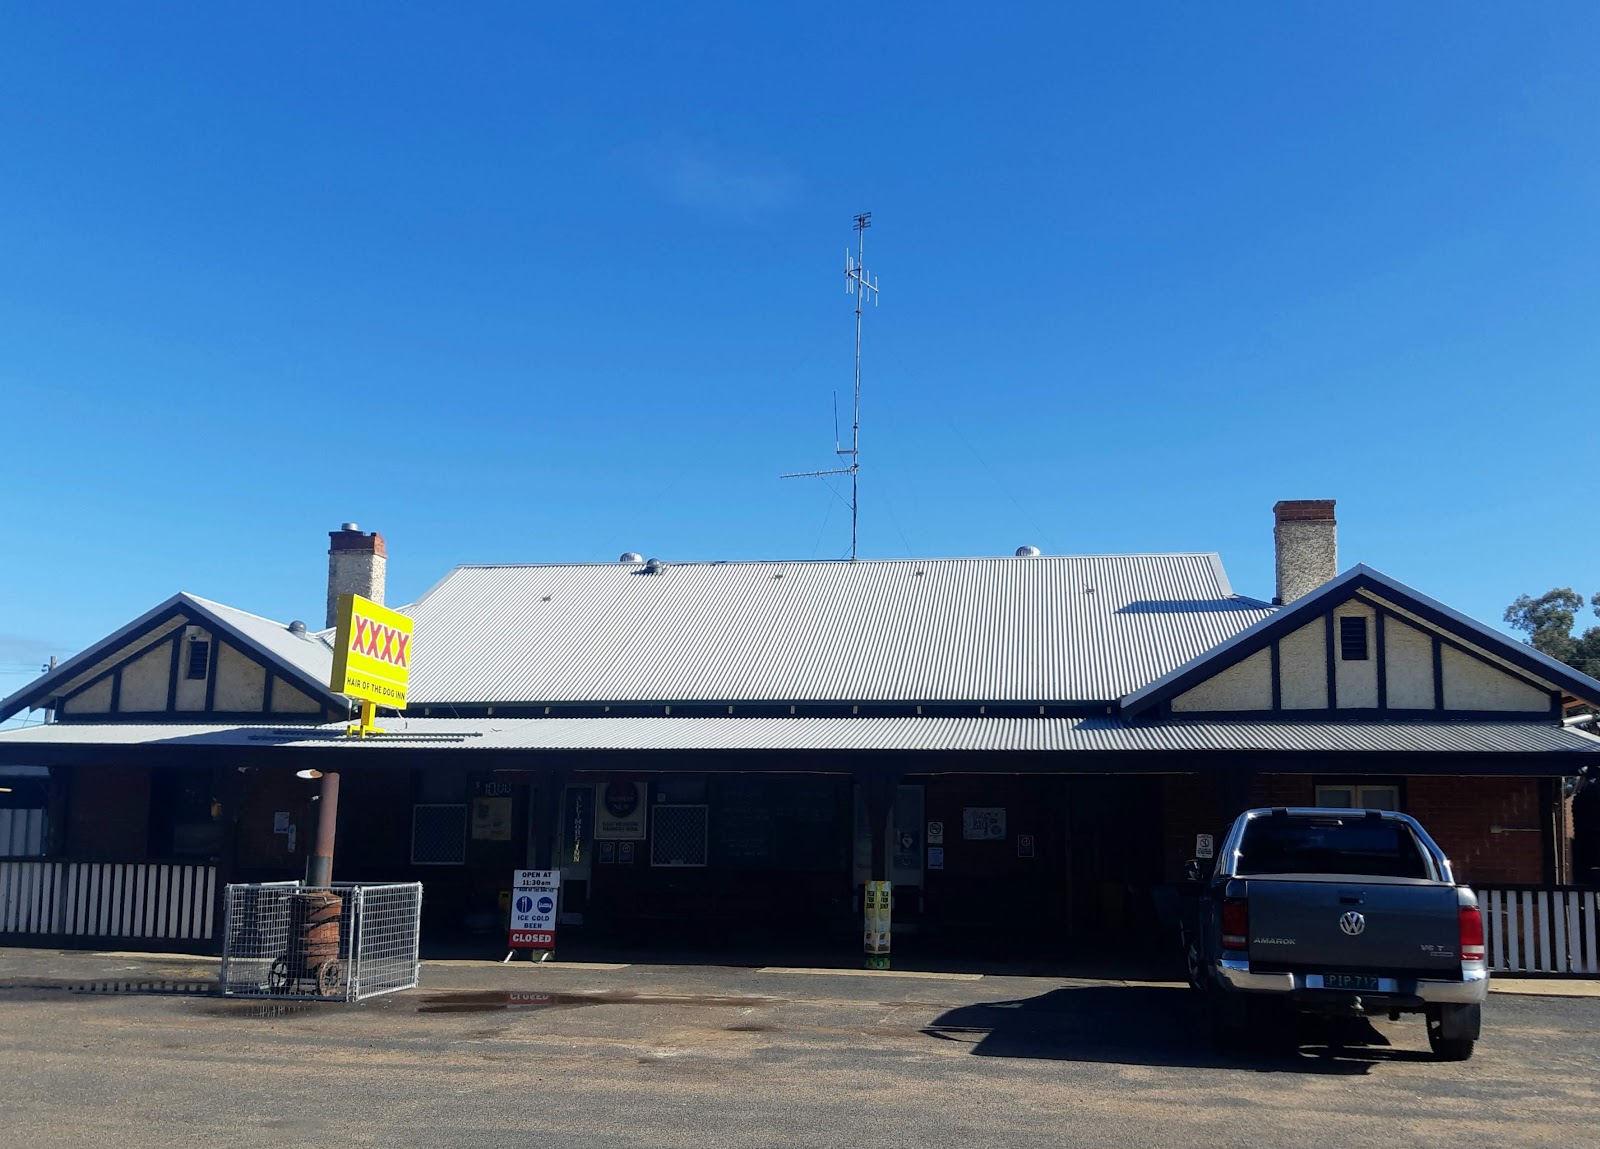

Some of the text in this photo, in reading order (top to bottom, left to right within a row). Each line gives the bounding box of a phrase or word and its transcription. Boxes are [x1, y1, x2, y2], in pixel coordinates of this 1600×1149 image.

[352, 614, 410, 668] XXXX
[346, 676, 406, 701] HAIR OF THE DOG INN
[512, 933, 552, 943] CLOSED
[1253, 937, 1296, 945] AMAROK
